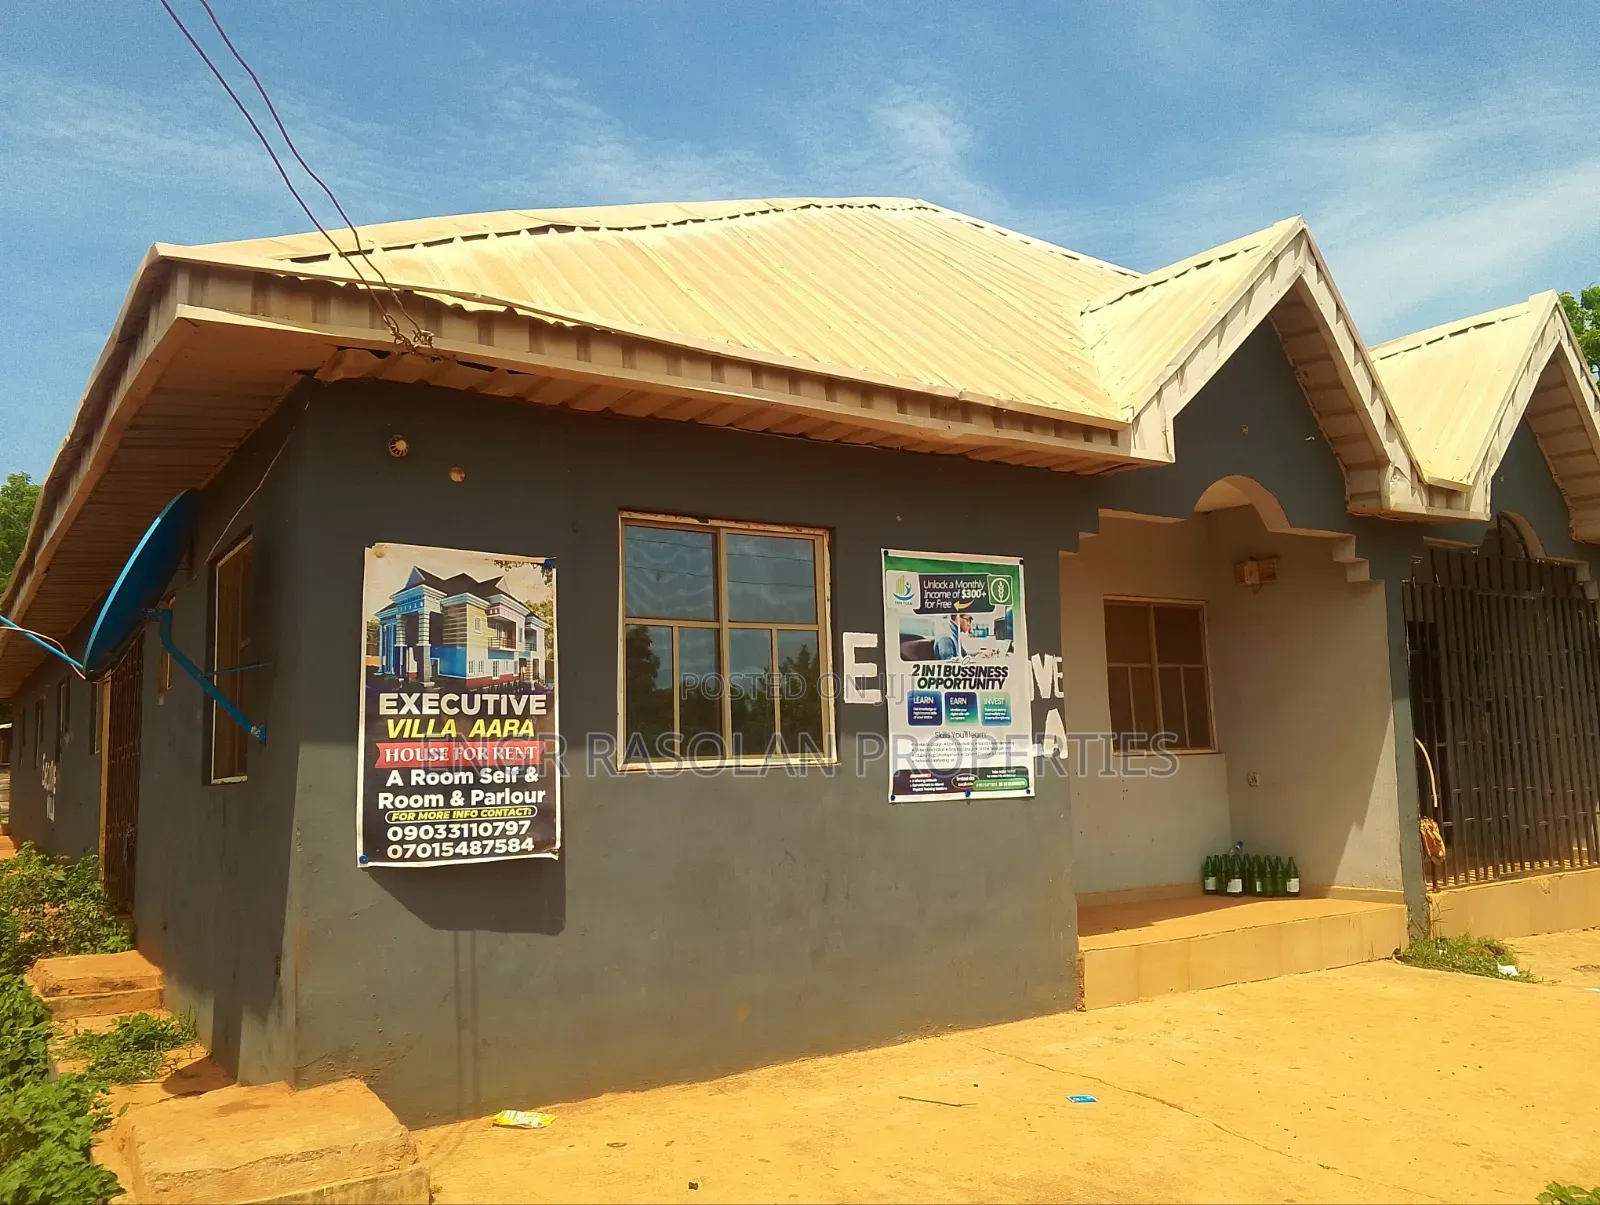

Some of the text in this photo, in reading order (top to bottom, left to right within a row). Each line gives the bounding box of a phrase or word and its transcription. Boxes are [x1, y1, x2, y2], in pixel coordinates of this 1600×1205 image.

[923, 580, 948, 589] Unlock
[955, 579, 986, 591] Monthly
[924, 589, 987, 599] Income of $300+
[925, 599, 953, 609] for Free
[912, 664, 1009, 678] 2 IN 1 BUSSINESS
[917, 677, 1006, 690] OPPORTUNITY
[379, 693, 547, 716] EXECUTIVE
[913, 696, 934, 704] LEARN
[949, 697, 968, 705] EARN
[983, 697, 1005, 705] INVEST
[387, 718, 535, 738] VILLA AARA
[934, 731, 951, 739] Skills
[385, 745, 539, 763] HOUSE FOR RENT
[386, 766, 540, 787] A Room Self &
[378, 788, 546, 809] Room & Parlour
[391, 807, 533, 822] FOR MORE INFO CONTACT:
[387, 820, 532, 841] 09033110797
[387, 836, 535, 859] 07015487584
